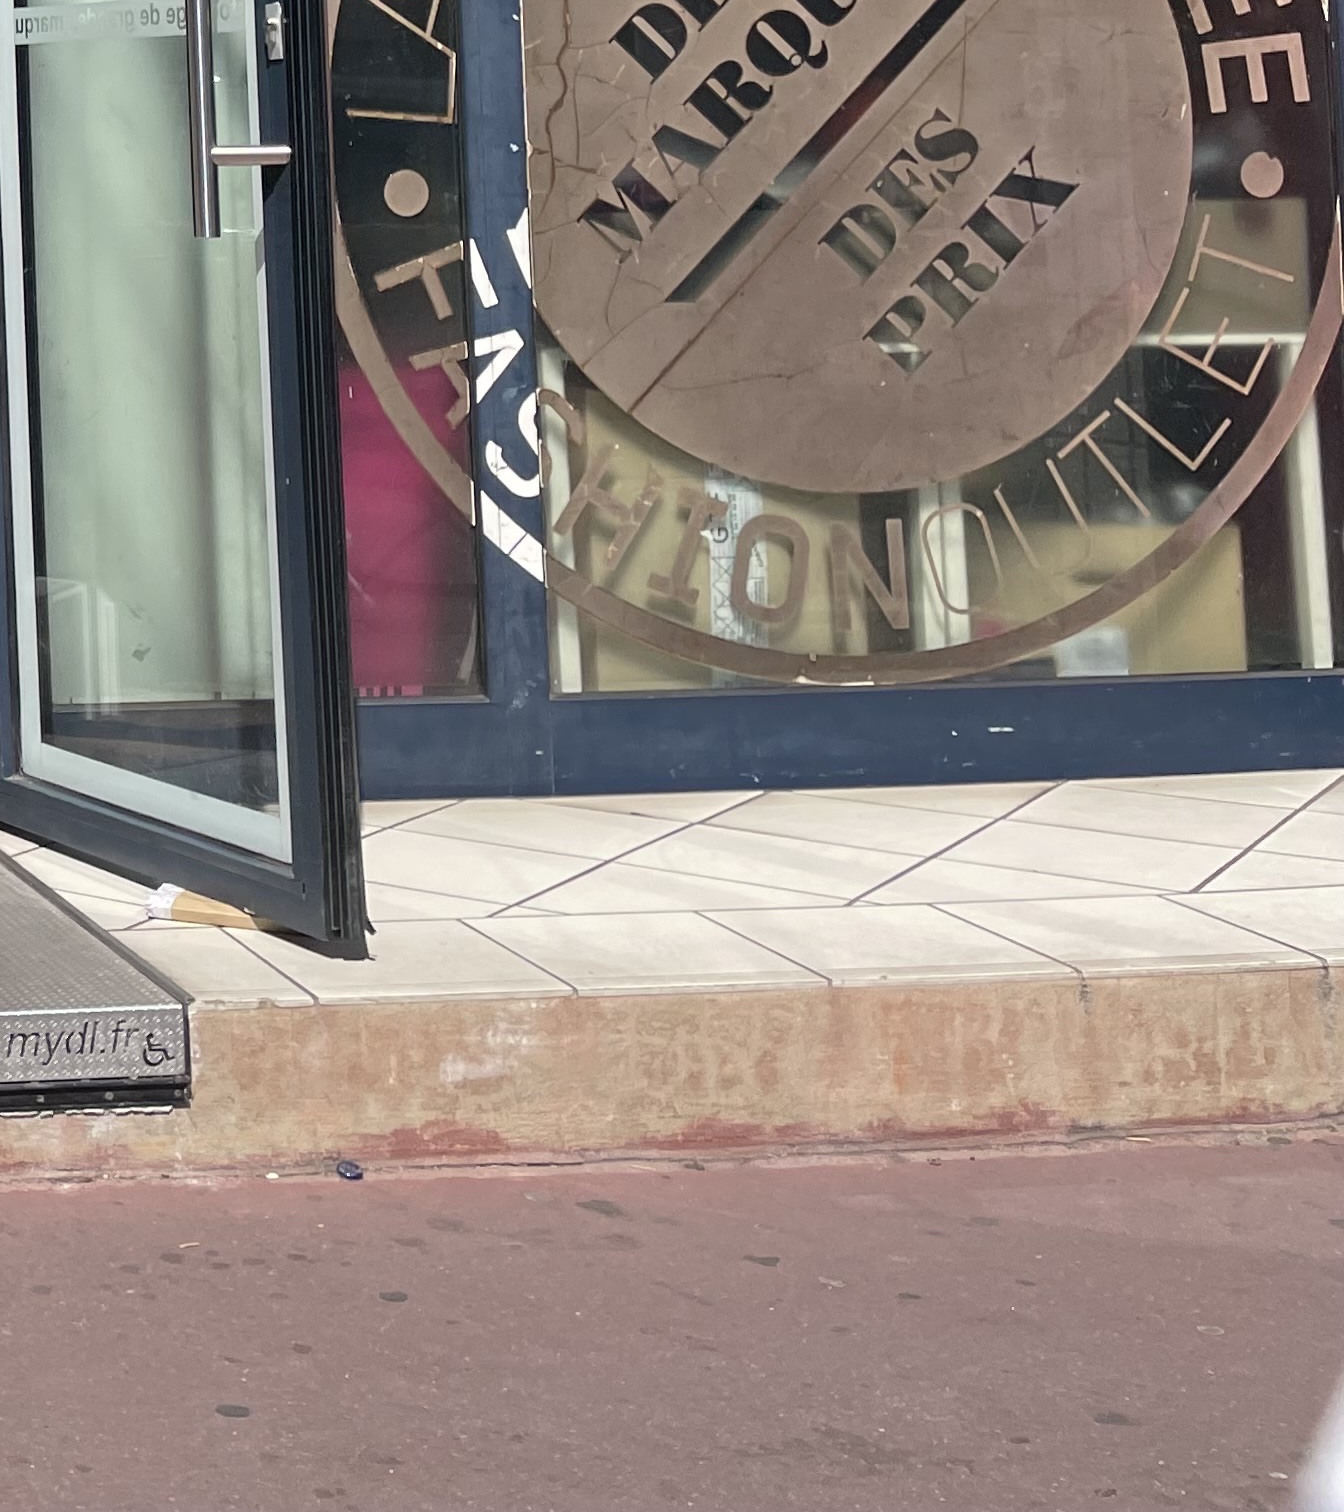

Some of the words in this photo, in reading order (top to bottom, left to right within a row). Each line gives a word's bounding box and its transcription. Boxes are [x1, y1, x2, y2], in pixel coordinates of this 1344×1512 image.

[818, 108, 981, 282] DES
[863, 144, 1081, 378] PRIX
[3, 1019, 142, 1065] mydl.fr
